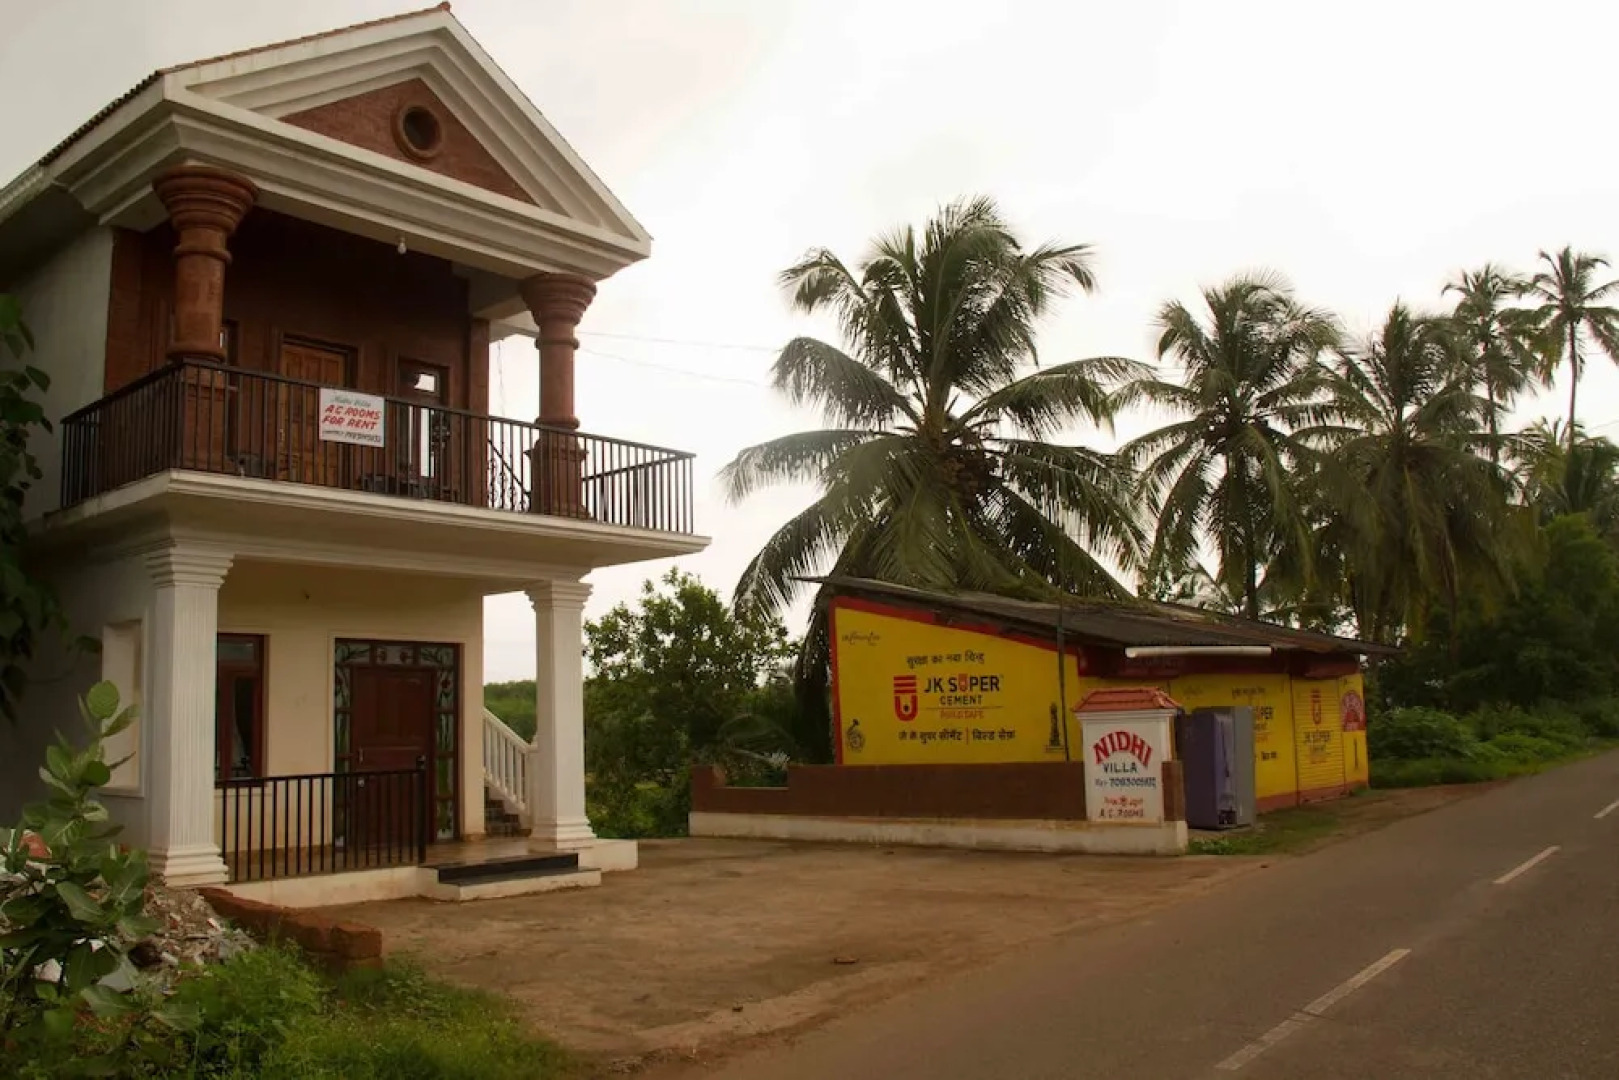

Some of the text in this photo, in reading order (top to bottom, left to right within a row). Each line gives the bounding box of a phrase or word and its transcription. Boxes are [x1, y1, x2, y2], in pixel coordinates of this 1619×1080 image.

[345, 407, 381, 420] ROOMS
[322, 415, 377, 430] FOR RENT
[923, 673, 1000, 694] JK SUPER
[939, 695, 983, 706] CEMENT
[1093, 731, 1152, 768] NIDHI
[1103, 762, 1137, 774] VILLA
